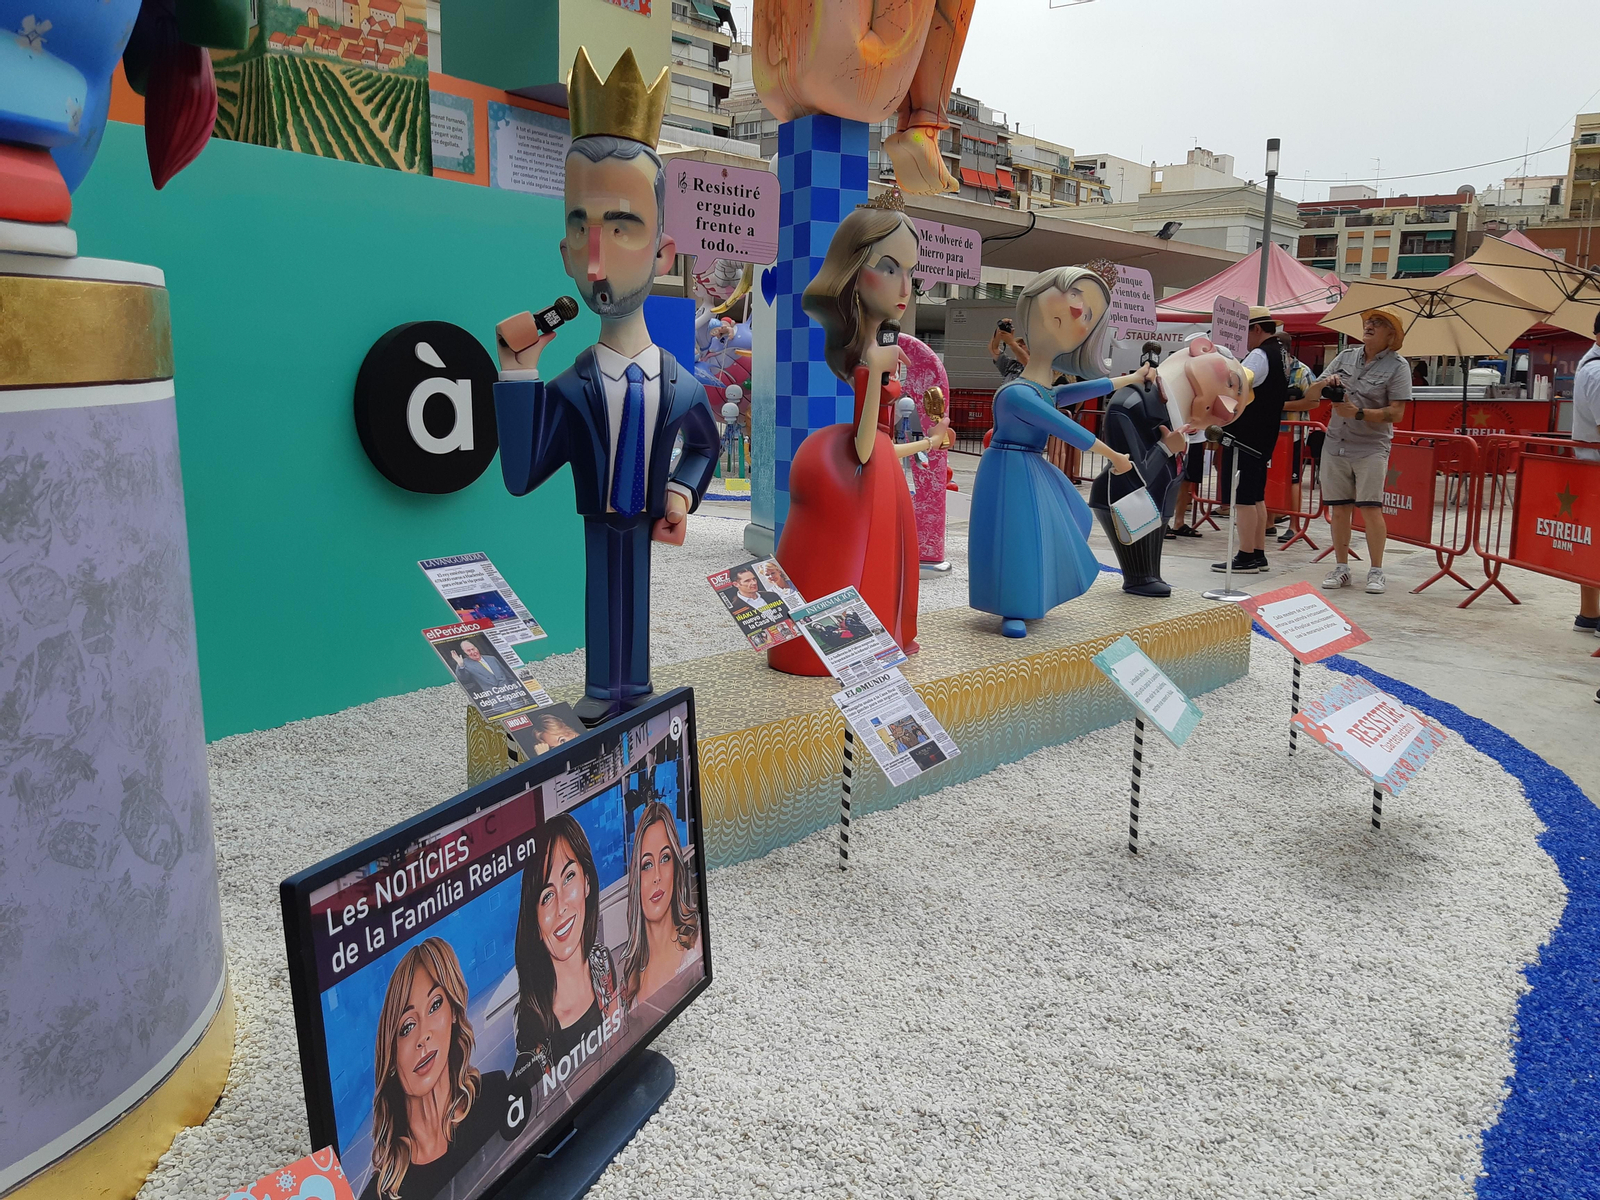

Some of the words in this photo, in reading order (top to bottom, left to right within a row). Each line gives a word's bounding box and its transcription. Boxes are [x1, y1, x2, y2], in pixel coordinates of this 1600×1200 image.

[693, 177, 760, 200] Resistiré
[696, 200, 756, 218] erguido
[696, 216, 742, 235] frente
[747, 226, 754, 236] a
[701, 237, 748, 255] todo...
[920, 229, 932, 242] Me
[935, 234, 962, 248] volveré
[964, 238, 974, 250] de
[920, 245, 944, 260] hierro
[946, 252, 964, 264] para
[915, 261, 945, 276] durecer
[946, 266, 954, 277] la
[1115, 287, 1140, 299] vientos
[1142, 291, 1150, 300] de
[1112, 300, 1122, 309] mi
[1124, 302, 1144, 312] nuera
[1130, 314, 1154, 326] fuertes
[406, 342, 474, 454] à
[1536, 518, 1592, 546] ESTRELLA
[1552, 539, 1572, 552] DAMM
[710, 572, 730, 584] DIEZ
[473, 690, 493, 700] Juan
[492, 683, 518, 694] Carlos
[844, 689, 857, 698] EL
[860, 674, 890, 692] MUNDO
[480, 698, 498, 708] deja
[496, 690, 526, 702] España
[326, 896, 370, 936] Les
[374, 836, 470, 909] NOTÍCIES
[332, 942, 359, 973] de
[365, 926, 386, 952] la
[390, 878, 464, 938] Família
[468, 845, 513, 892] Reial
[516, 837, 536, 862] en
[507, 1094, 524, 1128] à
[542, 1008, 620, 1097] NOTÍCIES
